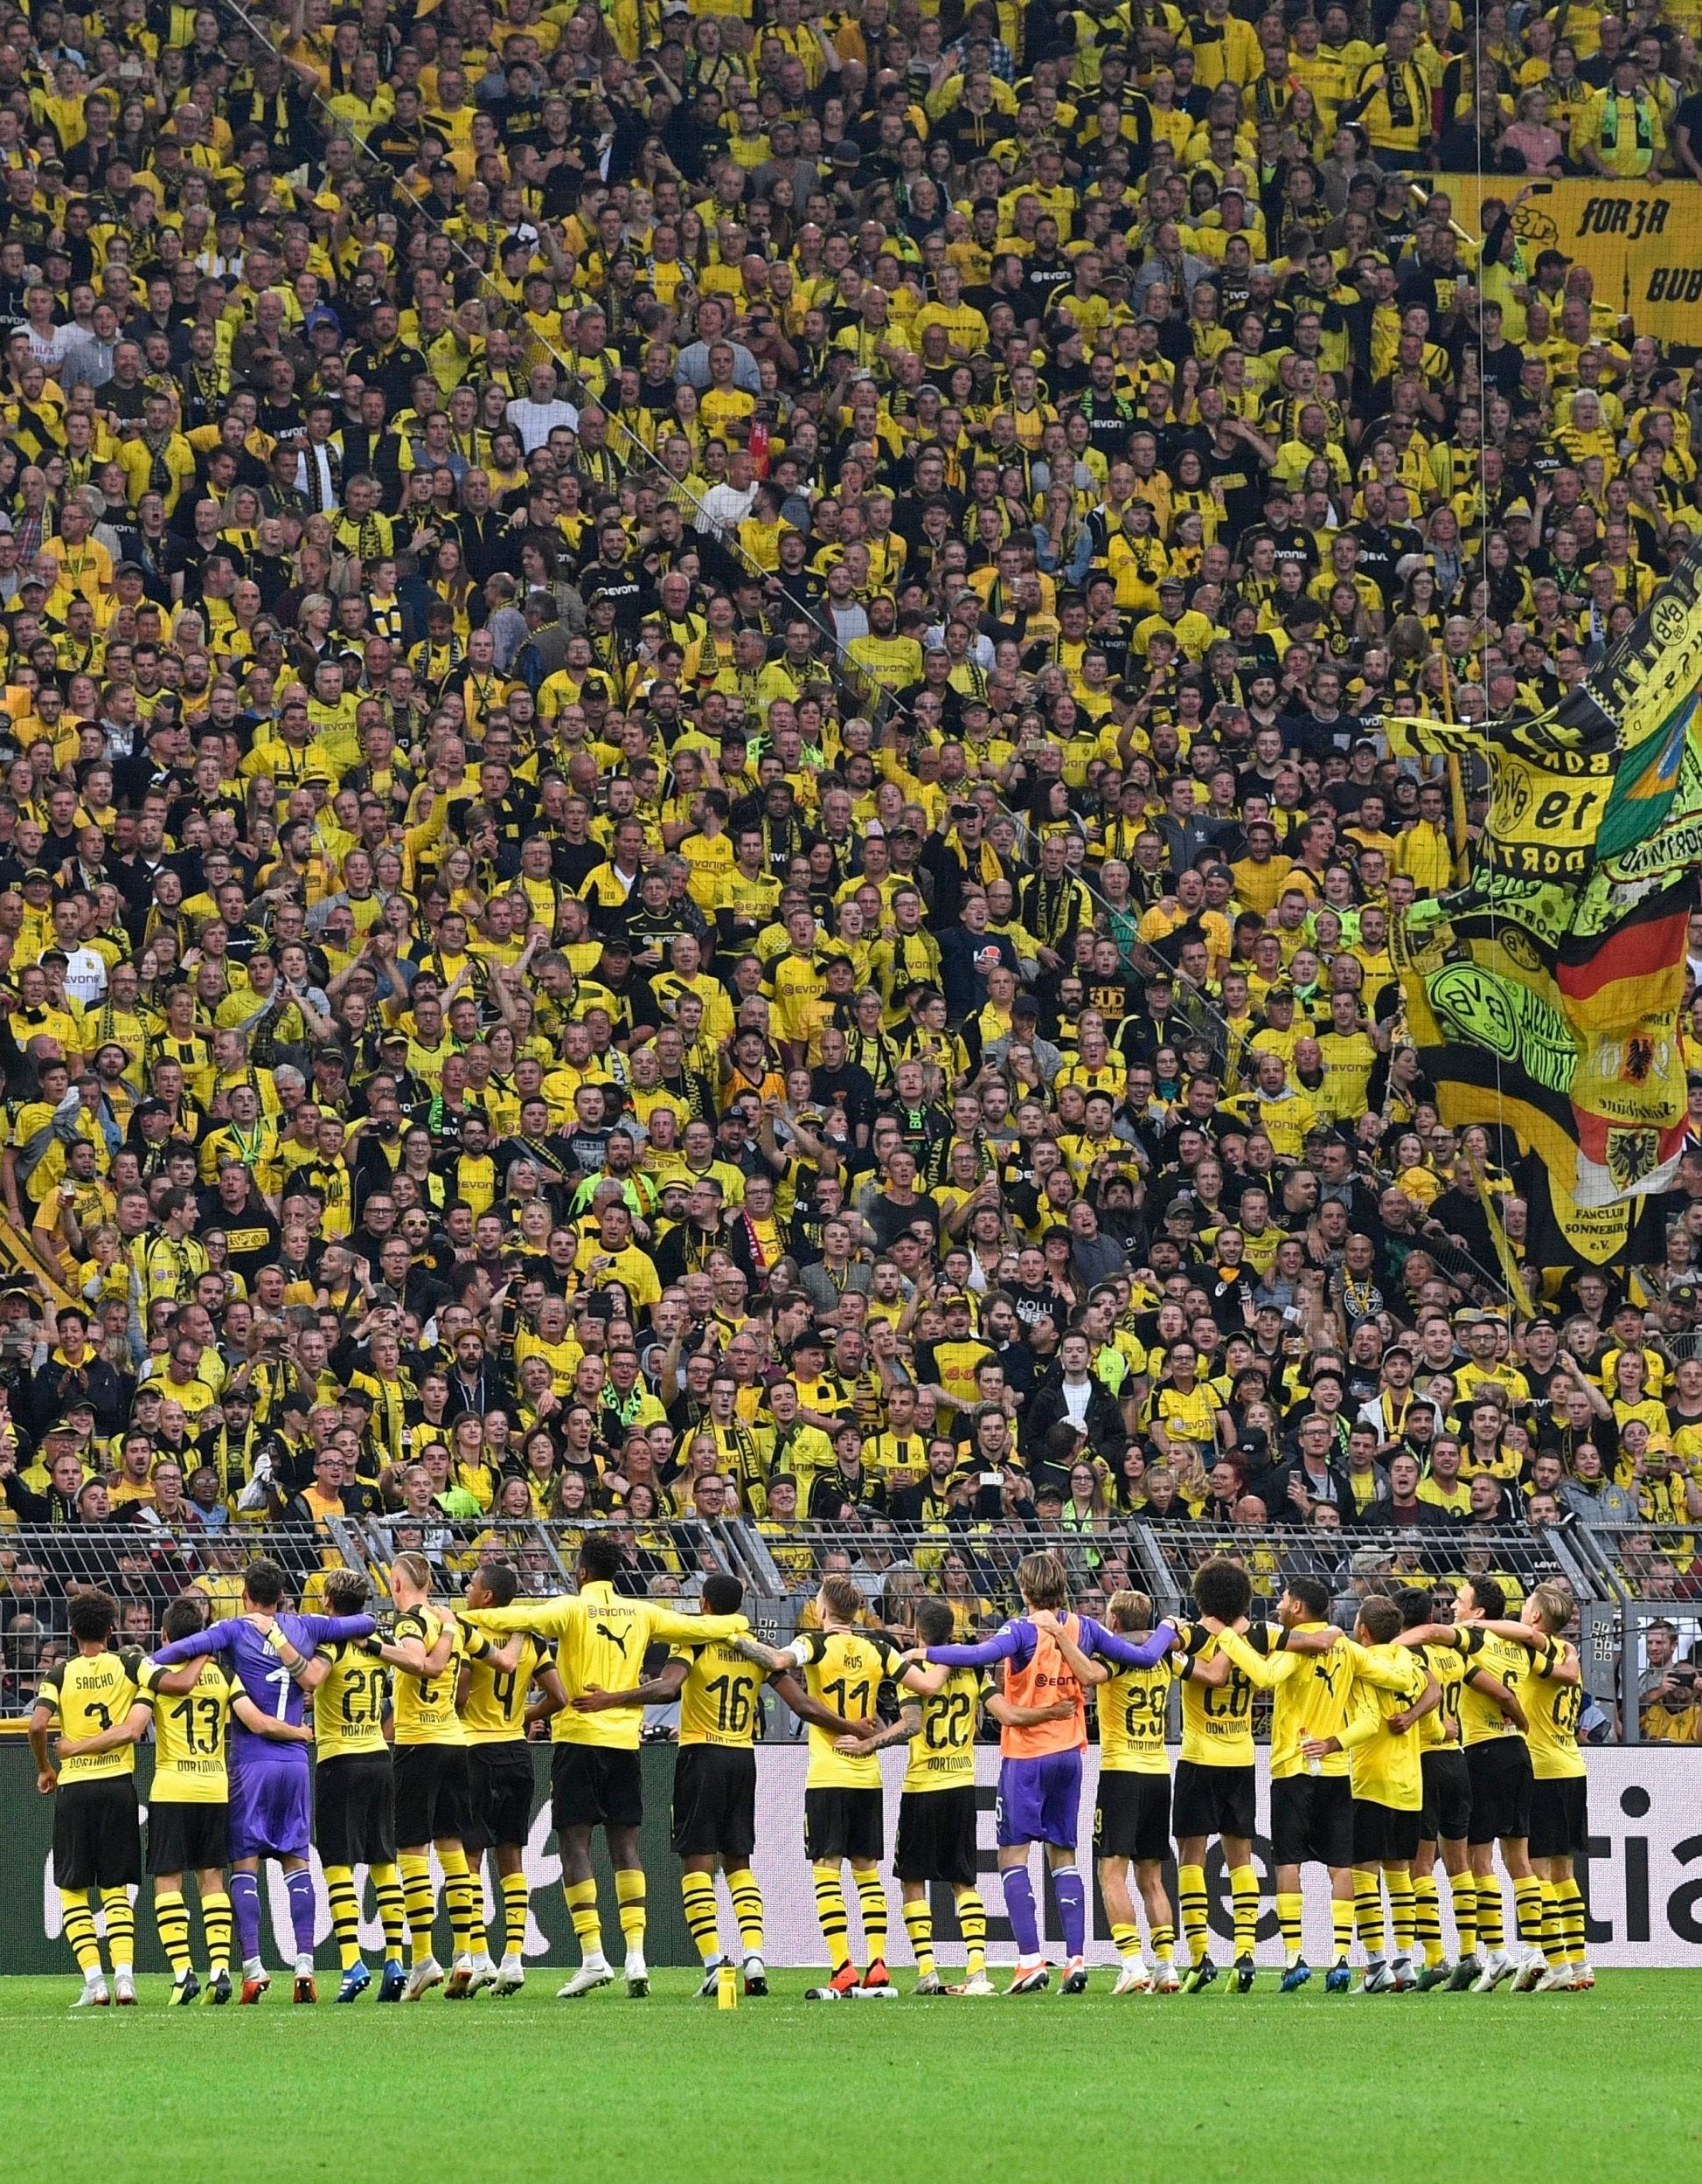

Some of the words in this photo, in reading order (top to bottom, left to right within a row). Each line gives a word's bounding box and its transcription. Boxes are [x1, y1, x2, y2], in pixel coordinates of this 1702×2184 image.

[844, 1654, 863, 1669] REUS
[76, 1673, 114, 1689] SANCHO
[342, 1668, 387, 1723] 20
[705, 1674, 754, 1733] 16
[926, 1692, 970, 1749] 22
[170, 1697, 220, 1754] 13
[177, 1760, 224, 1772] DORTMUND
[927, 1756, 972, 1771] DORTMUND
